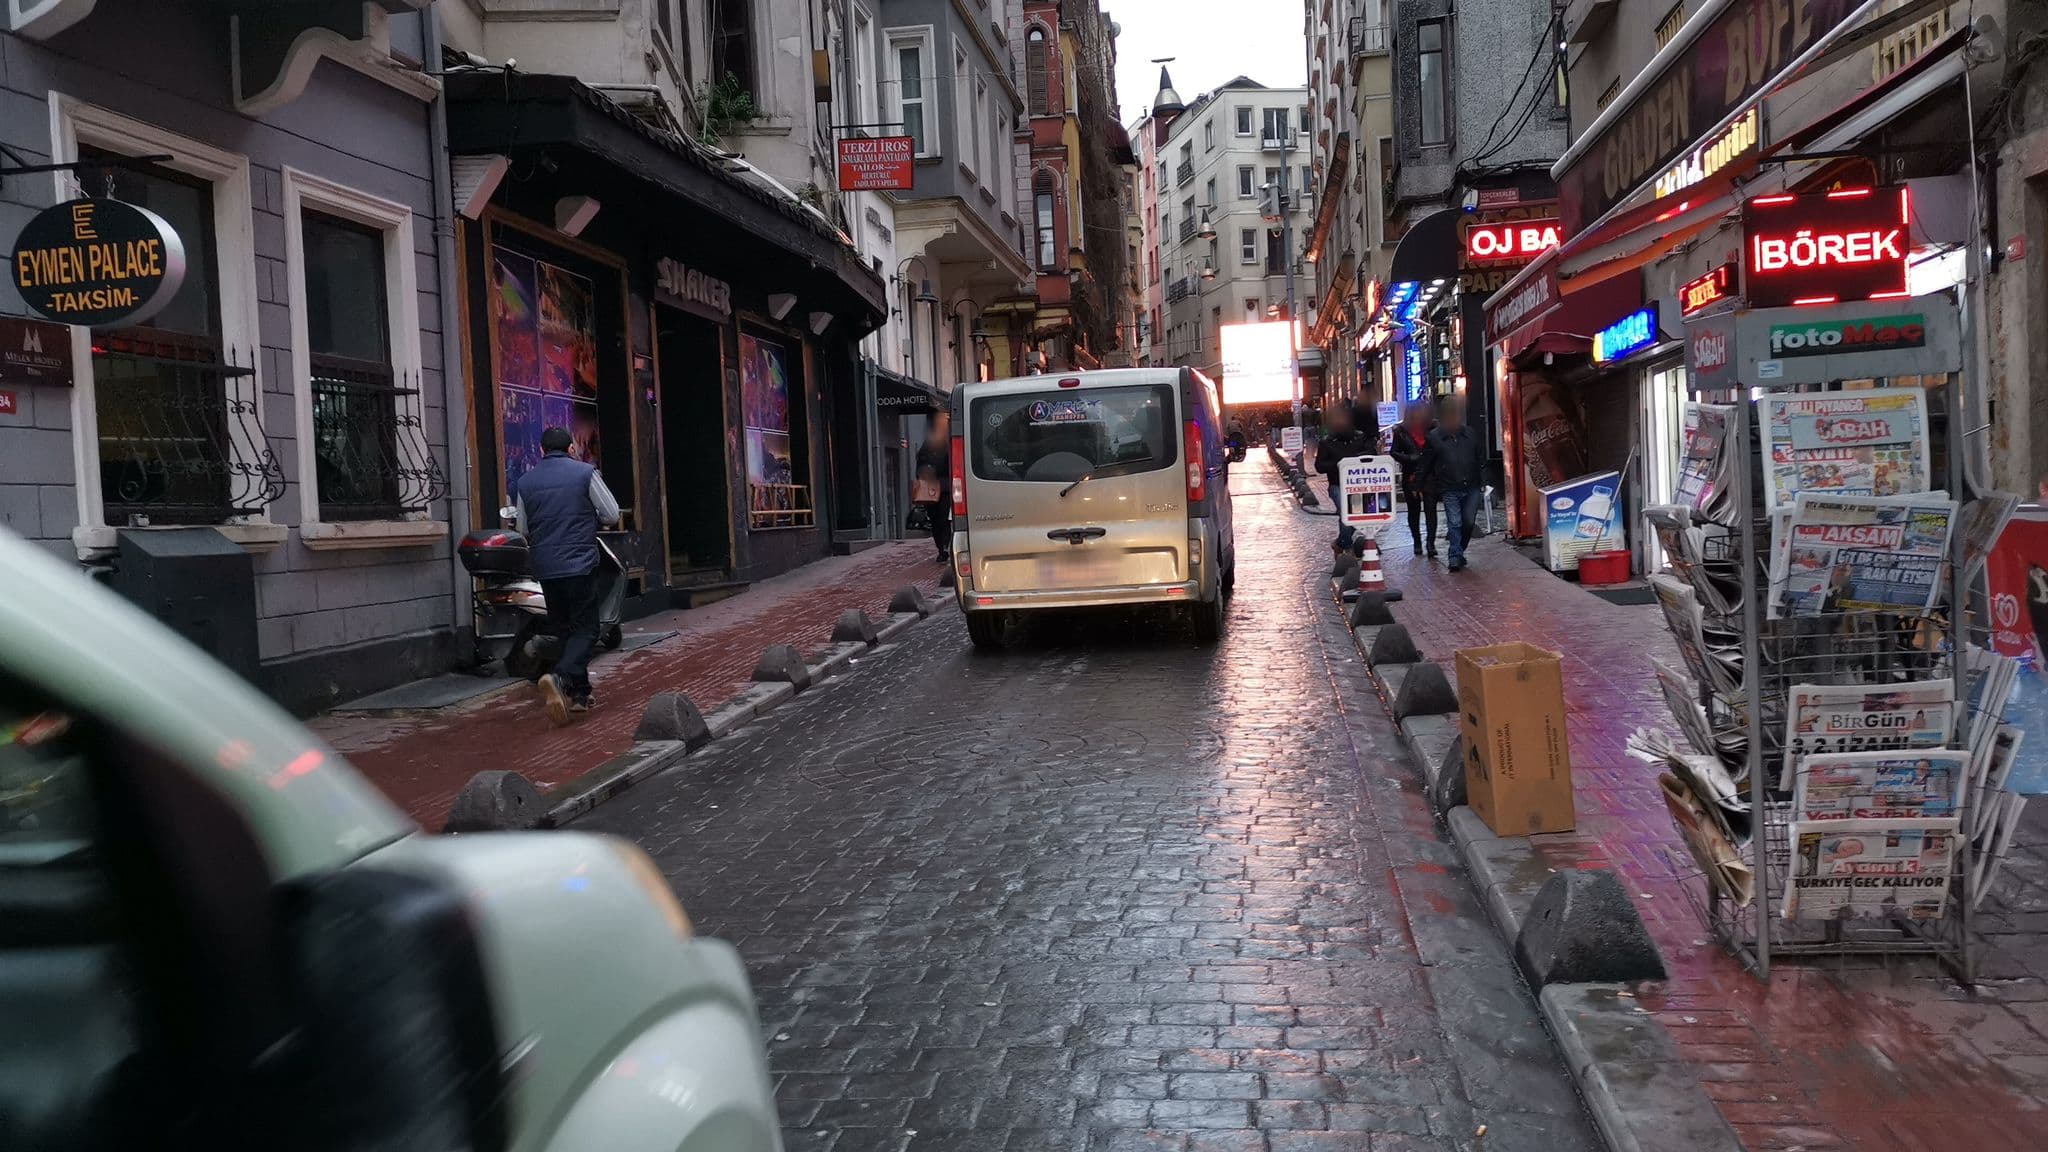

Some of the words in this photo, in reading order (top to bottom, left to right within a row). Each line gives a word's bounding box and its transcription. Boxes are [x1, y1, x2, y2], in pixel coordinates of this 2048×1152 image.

[843, 140, 877, 153] TERZİ
[880, 139, 909, 152] İROS
[1604, 65, 1689, 199] GOLDEN
[1470, 228, 1513, 255] OJ
[1521, 226, 1561, 252] BA
[1761, 230, 1900, 270] BÖREK
[18, 246, 84, 287] EYMEN
[89, 239, 161, 281] PALACE
[657, 256, 731, 315] SHAKER
[1693, 335, 1726, 368] SABAH
[903, 395, 928, 404] HOTEL
